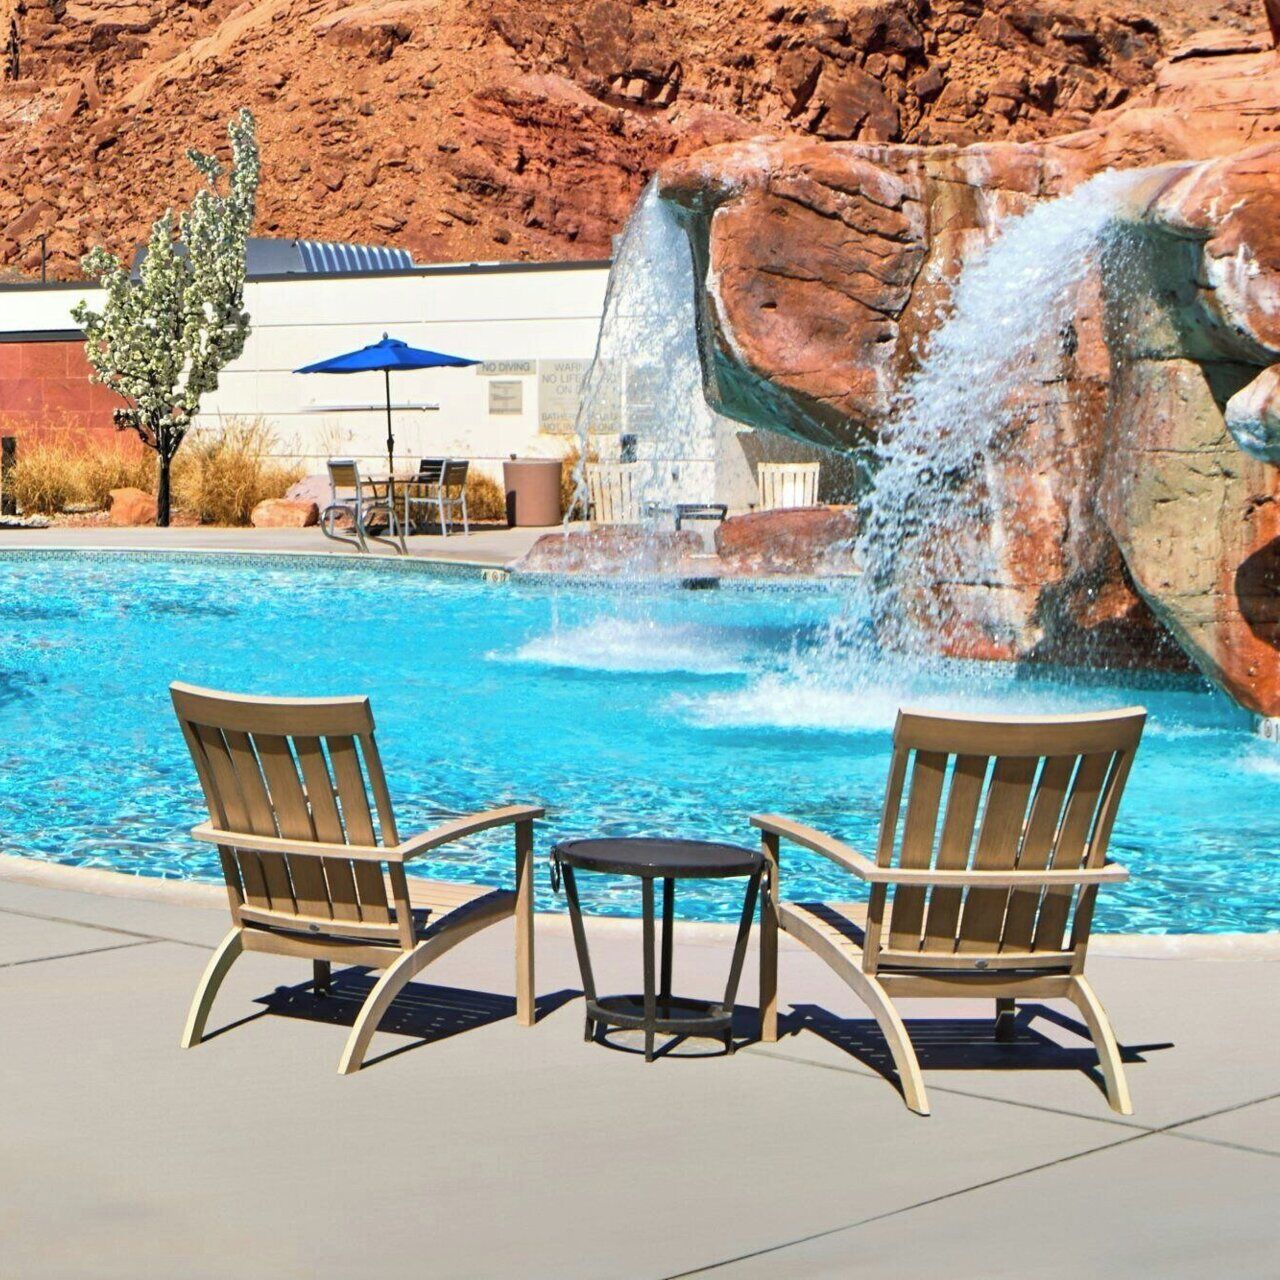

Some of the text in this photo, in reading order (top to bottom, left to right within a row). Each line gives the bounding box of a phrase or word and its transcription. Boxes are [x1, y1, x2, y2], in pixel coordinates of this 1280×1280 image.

[481, 362, 530, 372] NO DIVING
[542, 374, 557, 384] NO
[556, 385, 572, 395] ON
